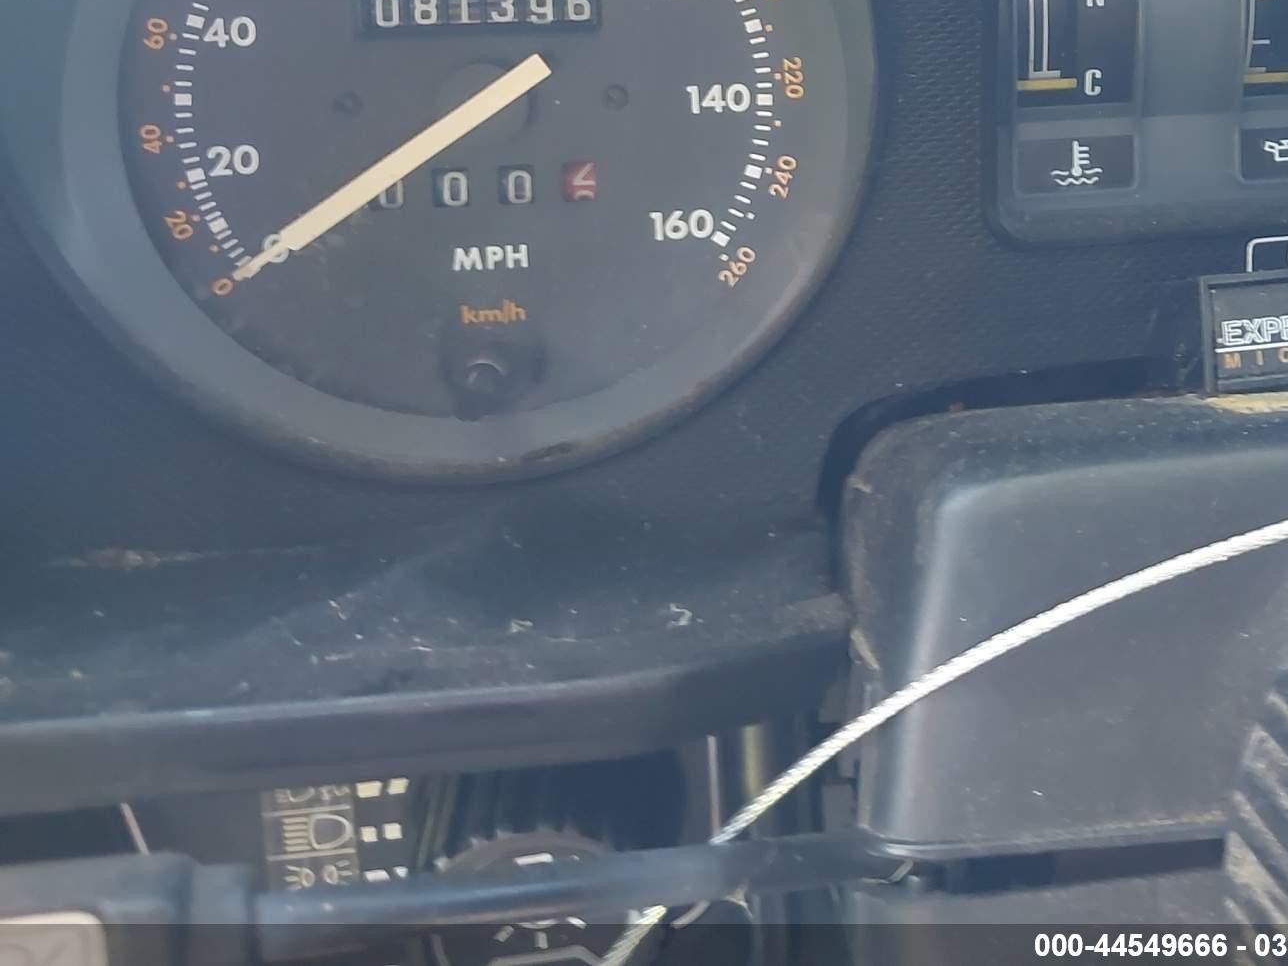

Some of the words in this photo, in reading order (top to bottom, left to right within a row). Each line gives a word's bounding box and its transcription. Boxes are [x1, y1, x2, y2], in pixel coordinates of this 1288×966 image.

[143, 17, 169, 50] 60
[203, 16, 257, 48] 40
[782, 56, 804, 99] 220
[1084, 69, 1102, 96] C
[686, 83, 751, 114] 140
[138, 124, 161, 154] 40
[206, 145, 260, 177] 20
[769, 155, 797, 199] 240
[164, 210, 193, 240] 20
[649, 209, 714, 241] 160
[453, 244, 529, 271] MPH
[718, 246, 756, 288] 260
[459, 299, 528, 324] km/h
